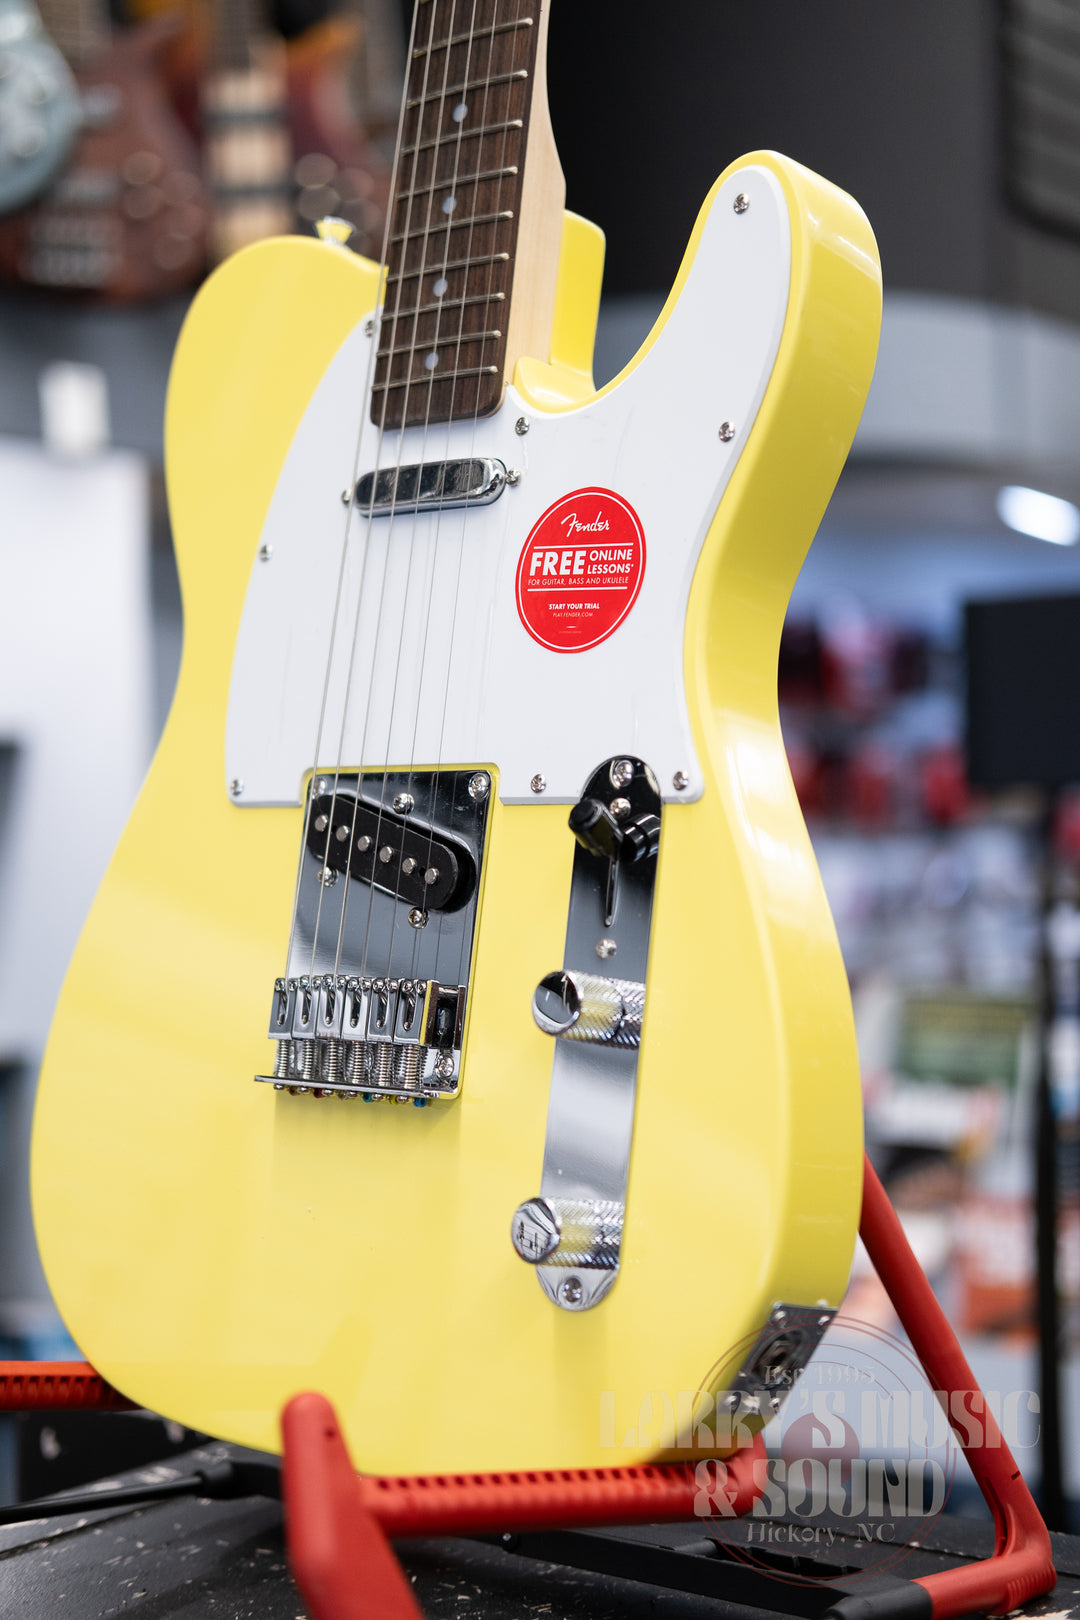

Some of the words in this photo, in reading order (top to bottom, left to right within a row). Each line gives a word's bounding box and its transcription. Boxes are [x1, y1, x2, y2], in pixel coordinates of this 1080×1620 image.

[560, 511, 610, 537] Fender
[589, 549, 633, 561] ONLINE
[529, 550, 587, 576] FREE
[568, 577, 584, 585] BASS
[585, 577, 601, 585] AND
[602, 576, 629, 584] UKULELE
[566, 602, 584, 610] YOUR
